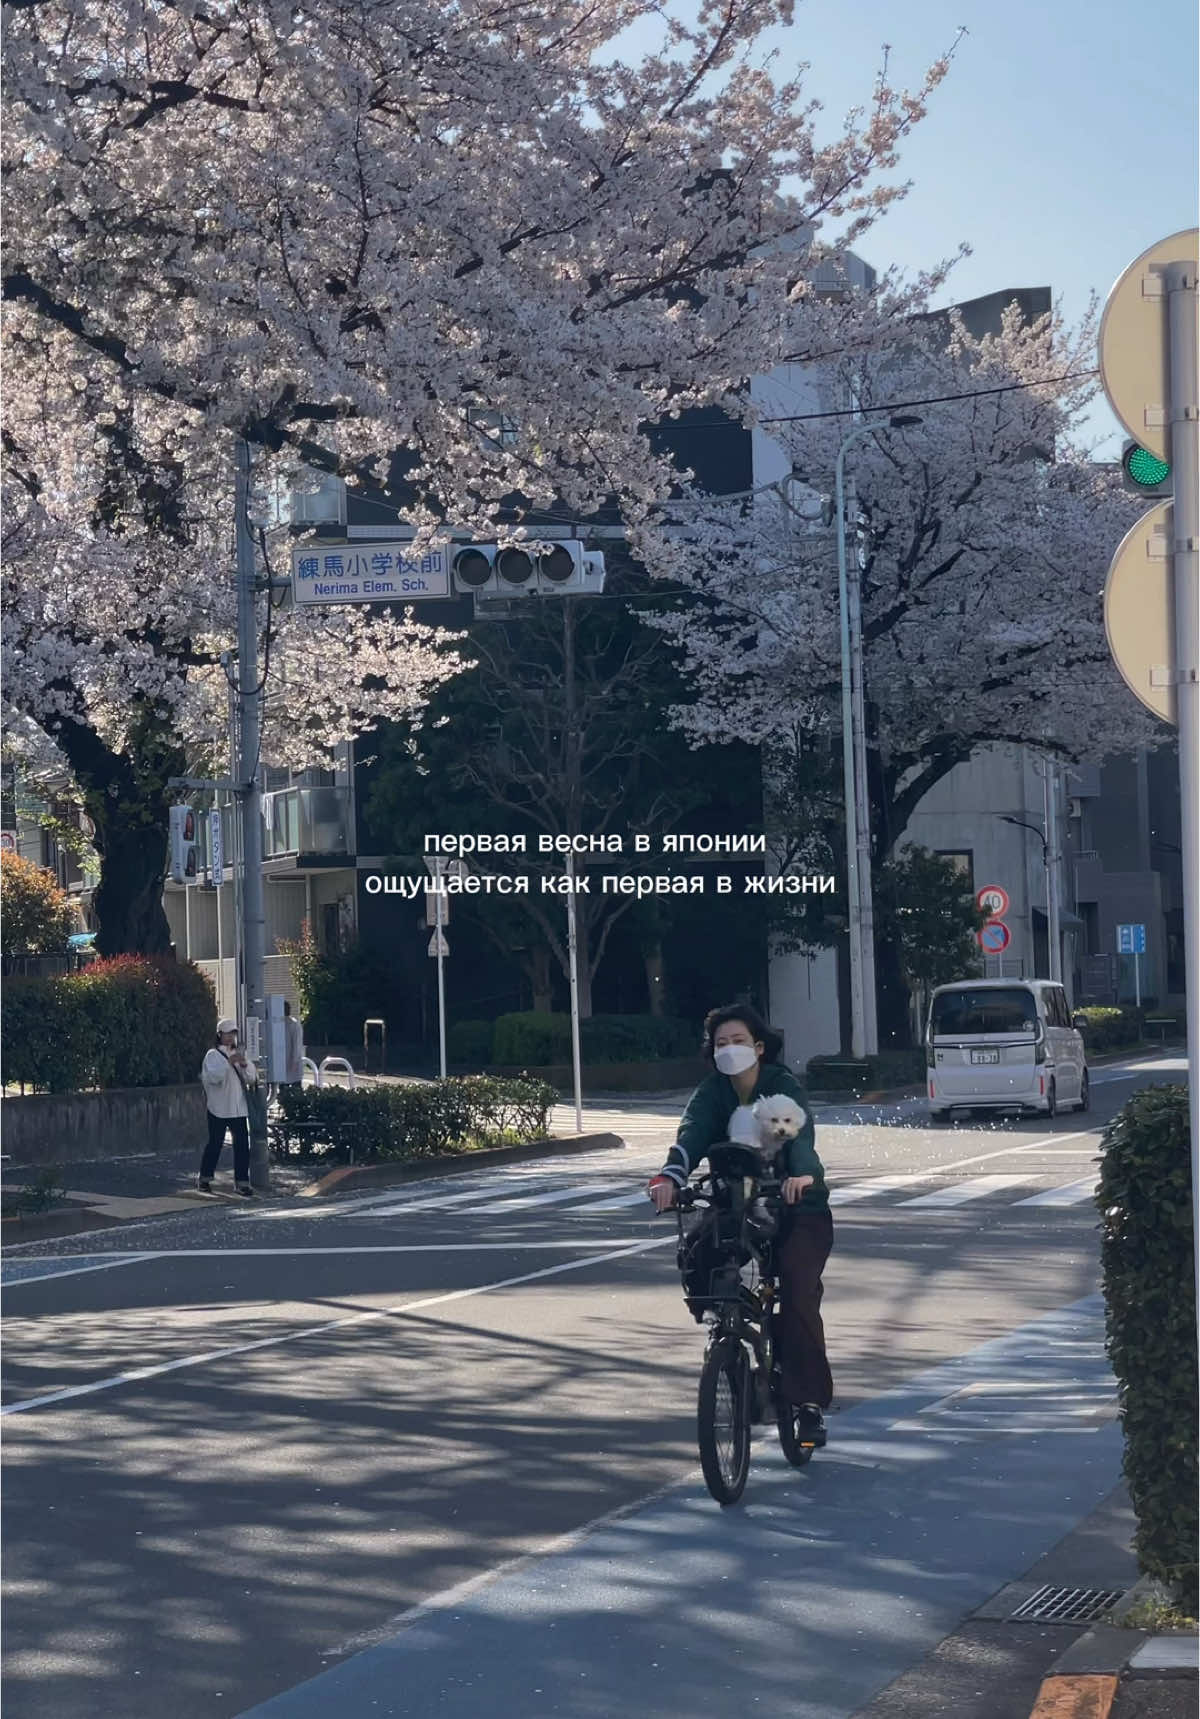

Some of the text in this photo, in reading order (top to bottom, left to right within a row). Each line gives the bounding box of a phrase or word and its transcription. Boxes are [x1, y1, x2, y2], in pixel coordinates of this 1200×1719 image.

[297, 552, 442, 580] 練馬小学校前
[314, 578, 429, 595] Nerima Elem. Sch.
